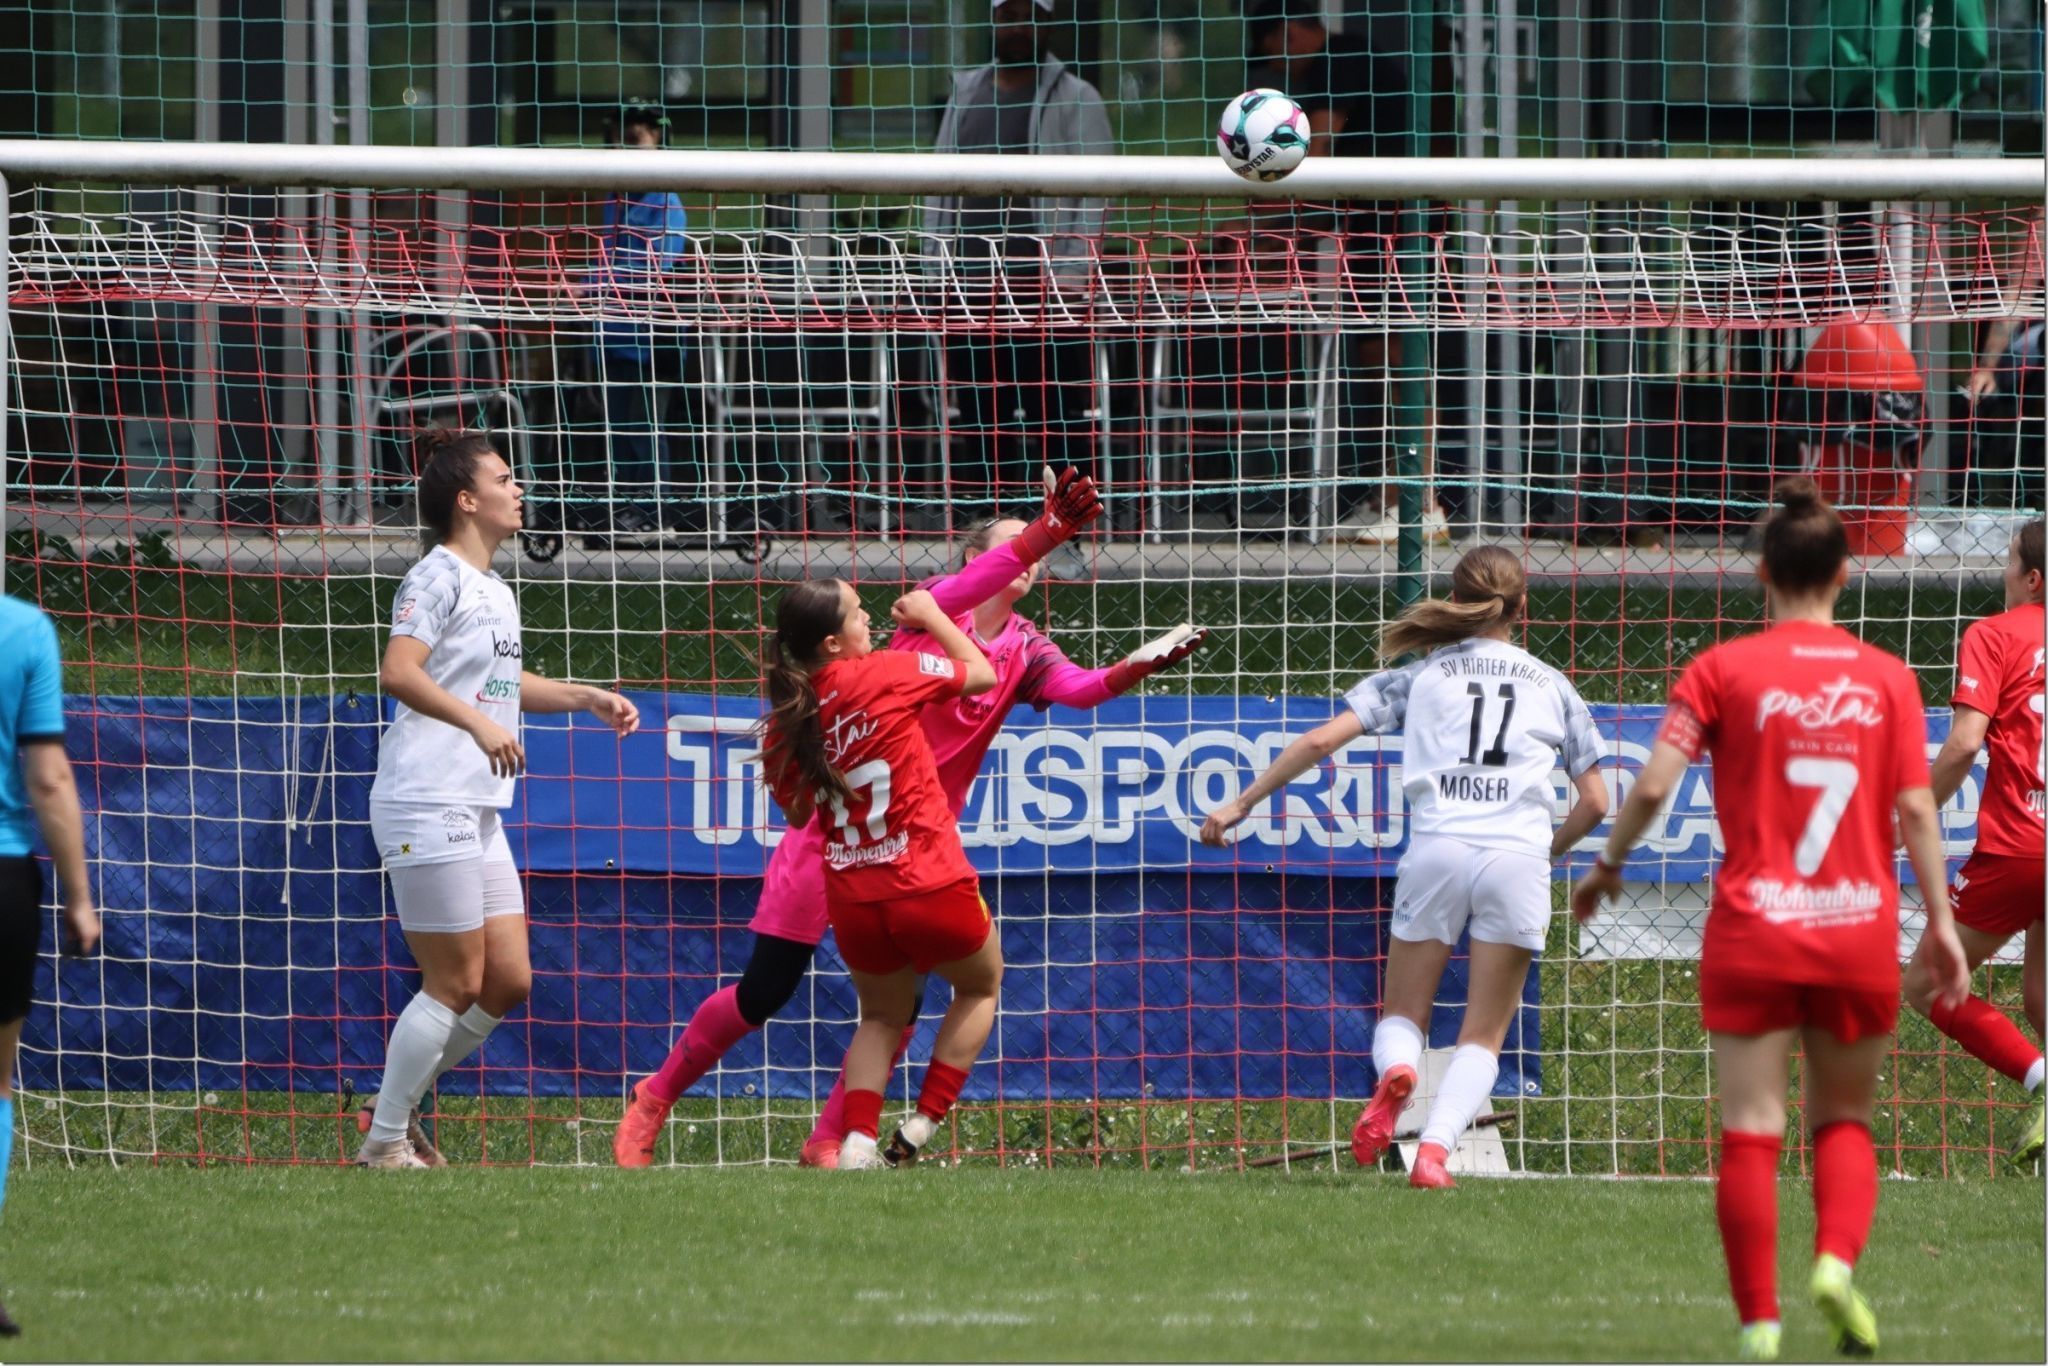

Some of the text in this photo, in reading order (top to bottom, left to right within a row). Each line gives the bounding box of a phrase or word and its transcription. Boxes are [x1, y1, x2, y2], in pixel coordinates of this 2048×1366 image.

[491, 629, 520, 659] kela
[1441, 657, 1549, 688] SV HIRTER KRAIG
[1757, 675, 1884, 733] postai
[1459, 681, 1516, 767] 11
[1789, 740, 1820, 752] SKIN
[1440, 774, 1510, 802] MOSER
[1785, 756, 1859, 878] 7
